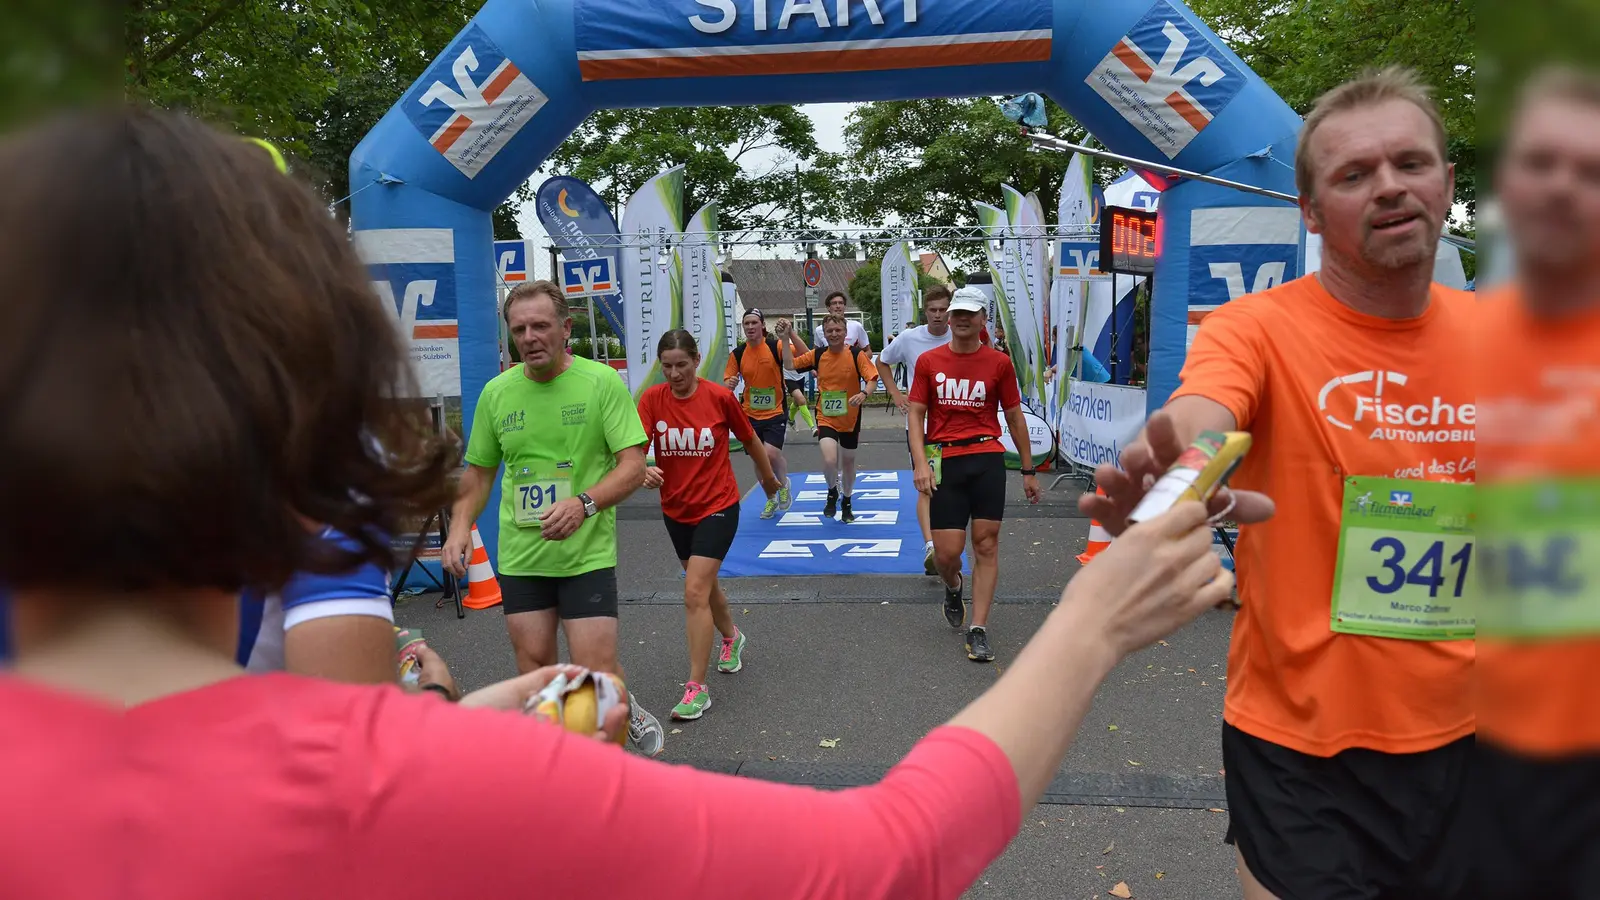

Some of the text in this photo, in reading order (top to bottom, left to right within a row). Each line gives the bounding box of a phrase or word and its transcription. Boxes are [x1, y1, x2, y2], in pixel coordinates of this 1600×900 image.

[474, 134, 484, 146] und
[482, 94, 524, 136] Raiffeisenbanken
[1099, 74, 1176, 147] im Landkreis Amberg-Sulzbach
[1121, 84, 1133, 97] und
[1132, 92, 1176, 134] Raiffeisenbanken
[465, 94, 535, 167] im Landkreis Amberg-Sulzbach
[639, 227, 653, 350] NUTRILITE
[890, 265, 899, 331] NUTRILITE
[754, 396, 771, 404] 279
[935, 372, 986, 401] iMA
[825, 400, 842, 409] 272
[1354, 396, 1475, 426] Fische
[656, 420, 715, 451] iMA
[1369, 427, 1475, 443] AUTOMOBIL
[1393, 461, 1424, 479] und
[520, 484, 556, 509] 791
[1370, 501, 1437, 517] firmenlauf
[1366, 536, 1473, 597] 341
[1390, 601, 1421, 613] Marco
